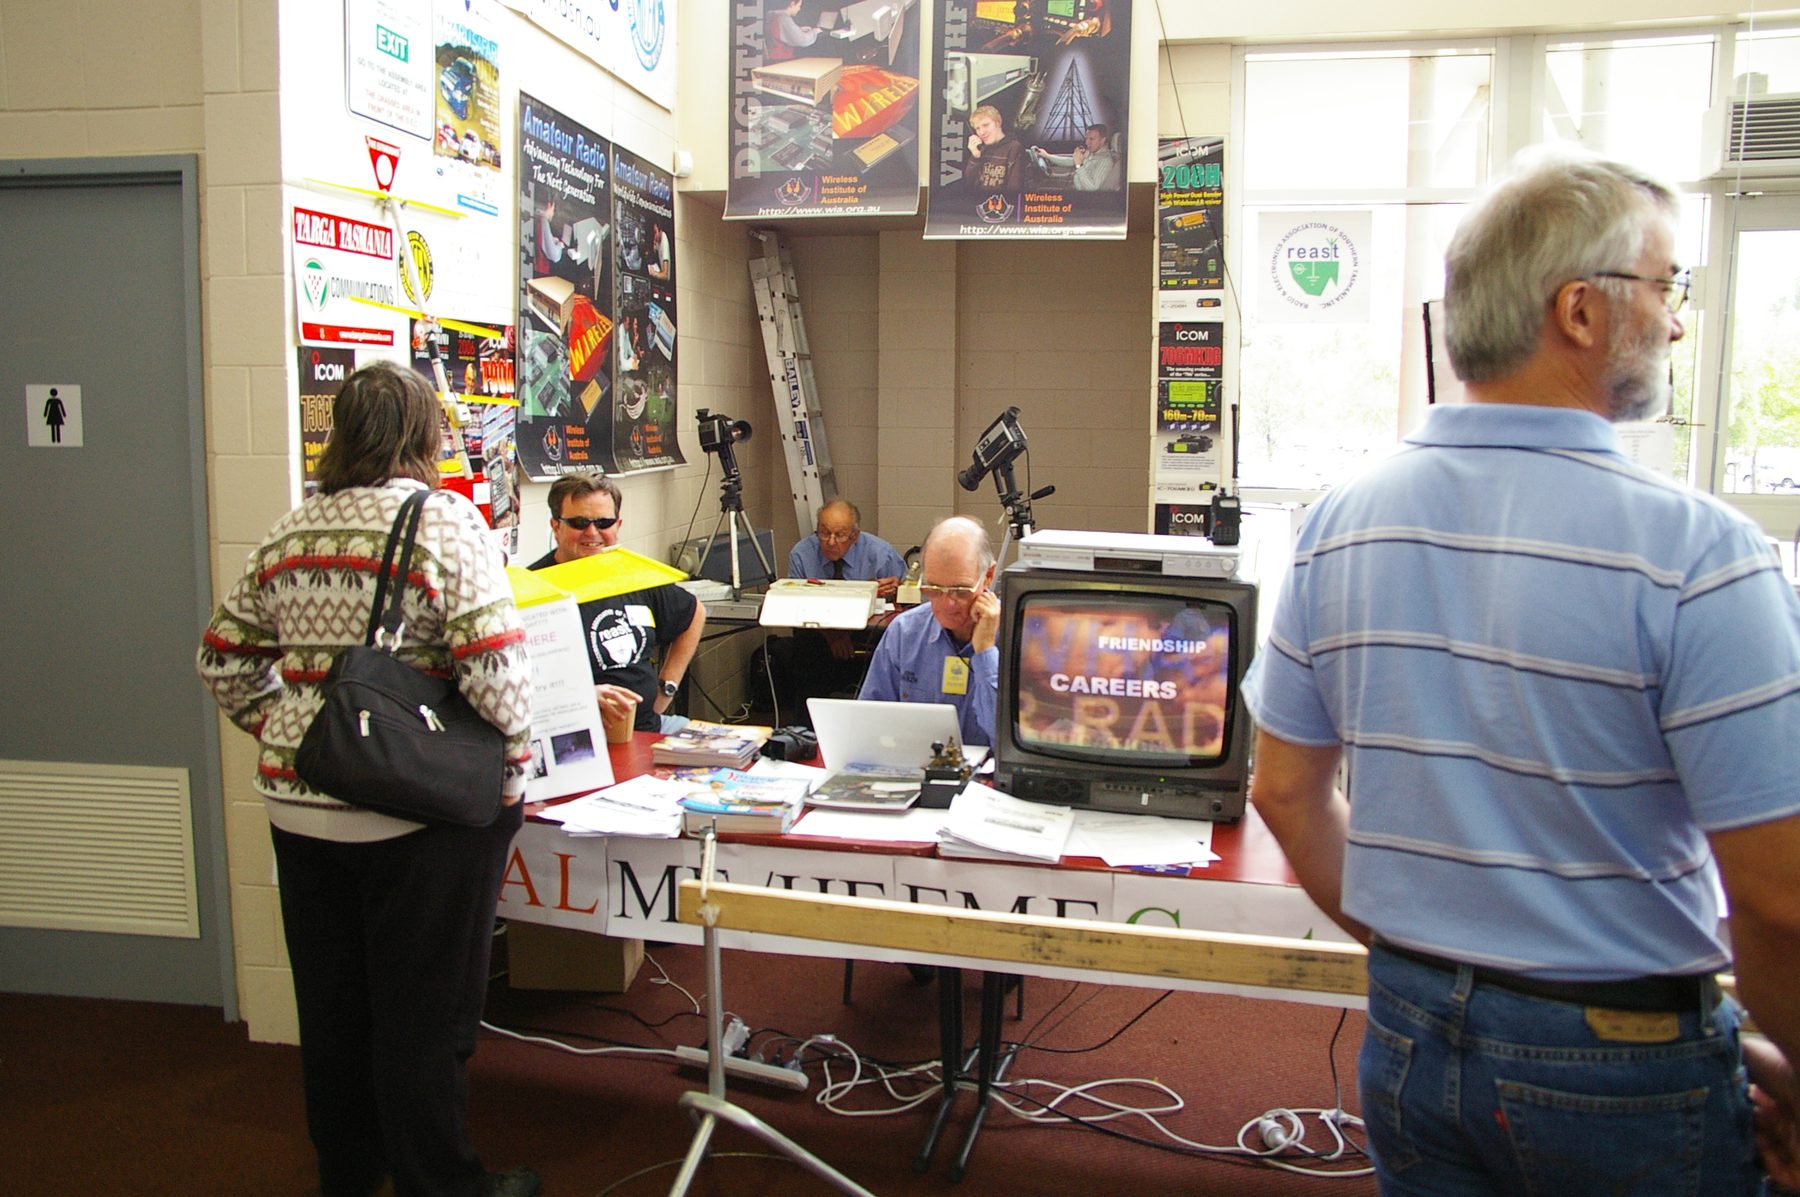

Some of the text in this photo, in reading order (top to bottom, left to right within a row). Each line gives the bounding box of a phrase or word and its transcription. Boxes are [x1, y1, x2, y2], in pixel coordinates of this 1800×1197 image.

[378, 27, 407, 60] EXIT
[523, 105, 574, 153] Amateur
[576, 133, 606, 172] Radio
[940, 114, 964, 187] VHF
[523, 138, 604, 193] Advancing Technology For
[533, 165, 545, 184] The
[546, 172, 562, 191] Next
[614, 153, 671, 201] Amateur Radio
[821, 176, 858, 184] Wireless
[1162, 163, 1220, 189] 208H
[821, 185, 867, 194] Institute of
[820, 196, 858, 204] Australia
[1024, 194, 1063, 202] Wireless
[758, 205, 880, 216] http://www.wia.org.au
[1024, 204, 1072, 212] Institute of
[1024, 215, 1063, 223] Australia
[295, 212, 392, 258] TARGA TASMANIA
[960, 225, 1087, 236] http://www.wia.org.au
[1287, 243, 1339, 259] reast
[1282, 222, 1328, 243] ASSOCIATION
[1335, 269, 1358, 302] TASMANIA
[331, 276, 394, 305] COMMUNICATIONS
[1176, 330, 1209, 341] ICOM
[458, 339, 475, 354] 2006
[314, 363, 344, 381] ICOM
[785, 360, 800, 408] BAILEY
[1163, 409, 1216, 421] 160m-70cm
[565, 425, 585, 435] Wireless
[566, 438, 590, 447] Institute of
[568, 451, 589, 461] Australia
[1172, 513, 1204, 524] ICOM
[525, 632, 557, 648] HERE
[598, 622, 633, 642] reast
[1098, 635, 1207, 654] FRIENDSHIP
[1050, 673, 1177, 700] CAREERS
